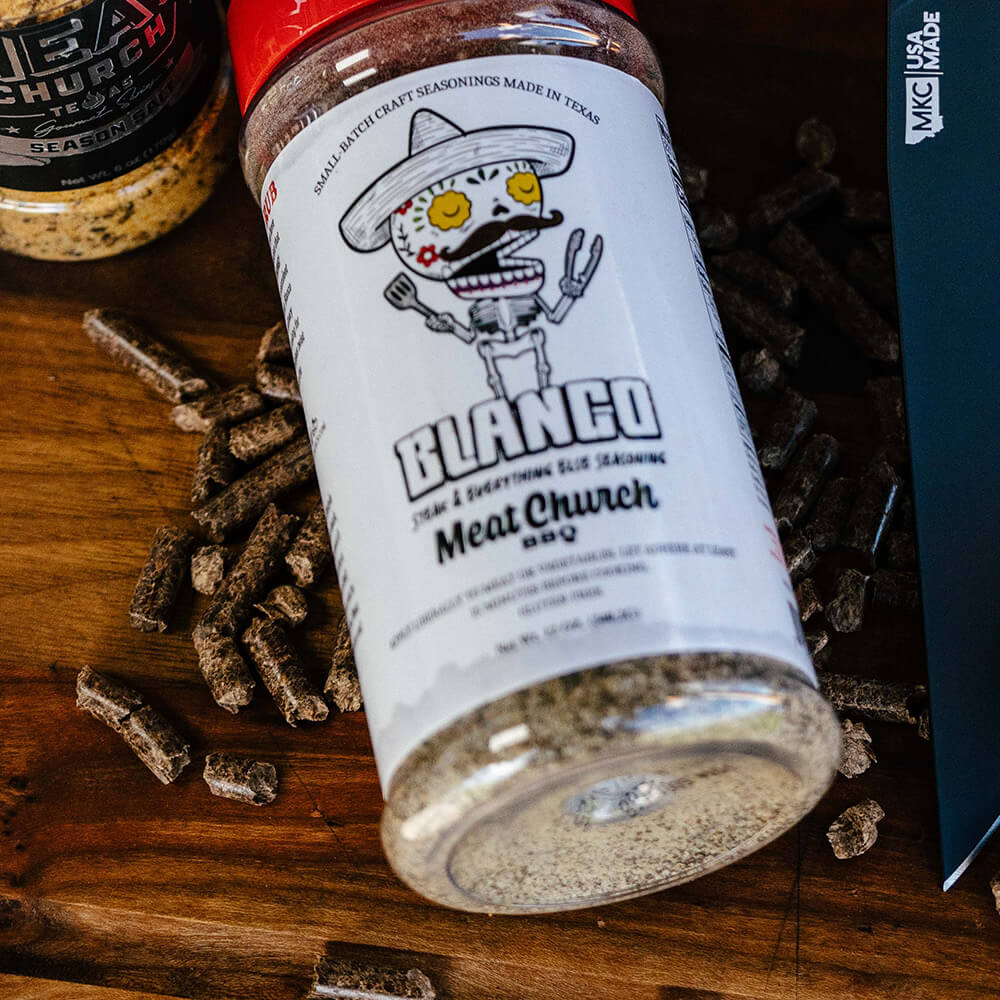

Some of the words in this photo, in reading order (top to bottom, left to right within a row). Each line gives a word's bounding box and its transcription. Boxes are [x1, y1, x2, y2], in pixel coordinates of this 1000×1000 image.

[906, 30, 923, 70] USA
[923, 11, 941, 70] MADE
[911, 81, 933, 131] MKC
[30, 119, 127, 154] SEASON
[313, 115, 375, 196] SMALL-BATCH
[375, 90, 414, 120] CRAFT
[415, 74, 501, 98] SEASONINGS
[503, 77, 544, 96] MADE
[546, 88, 562, 102] IN
[565, 95, 600, 126] TEXAS
[393, 376, 662, 502] BLANCO
[433, 501, 521, 565] Meat
[523, 476, 660, 530] Church
[521, 524, 578, 550] BBQ
